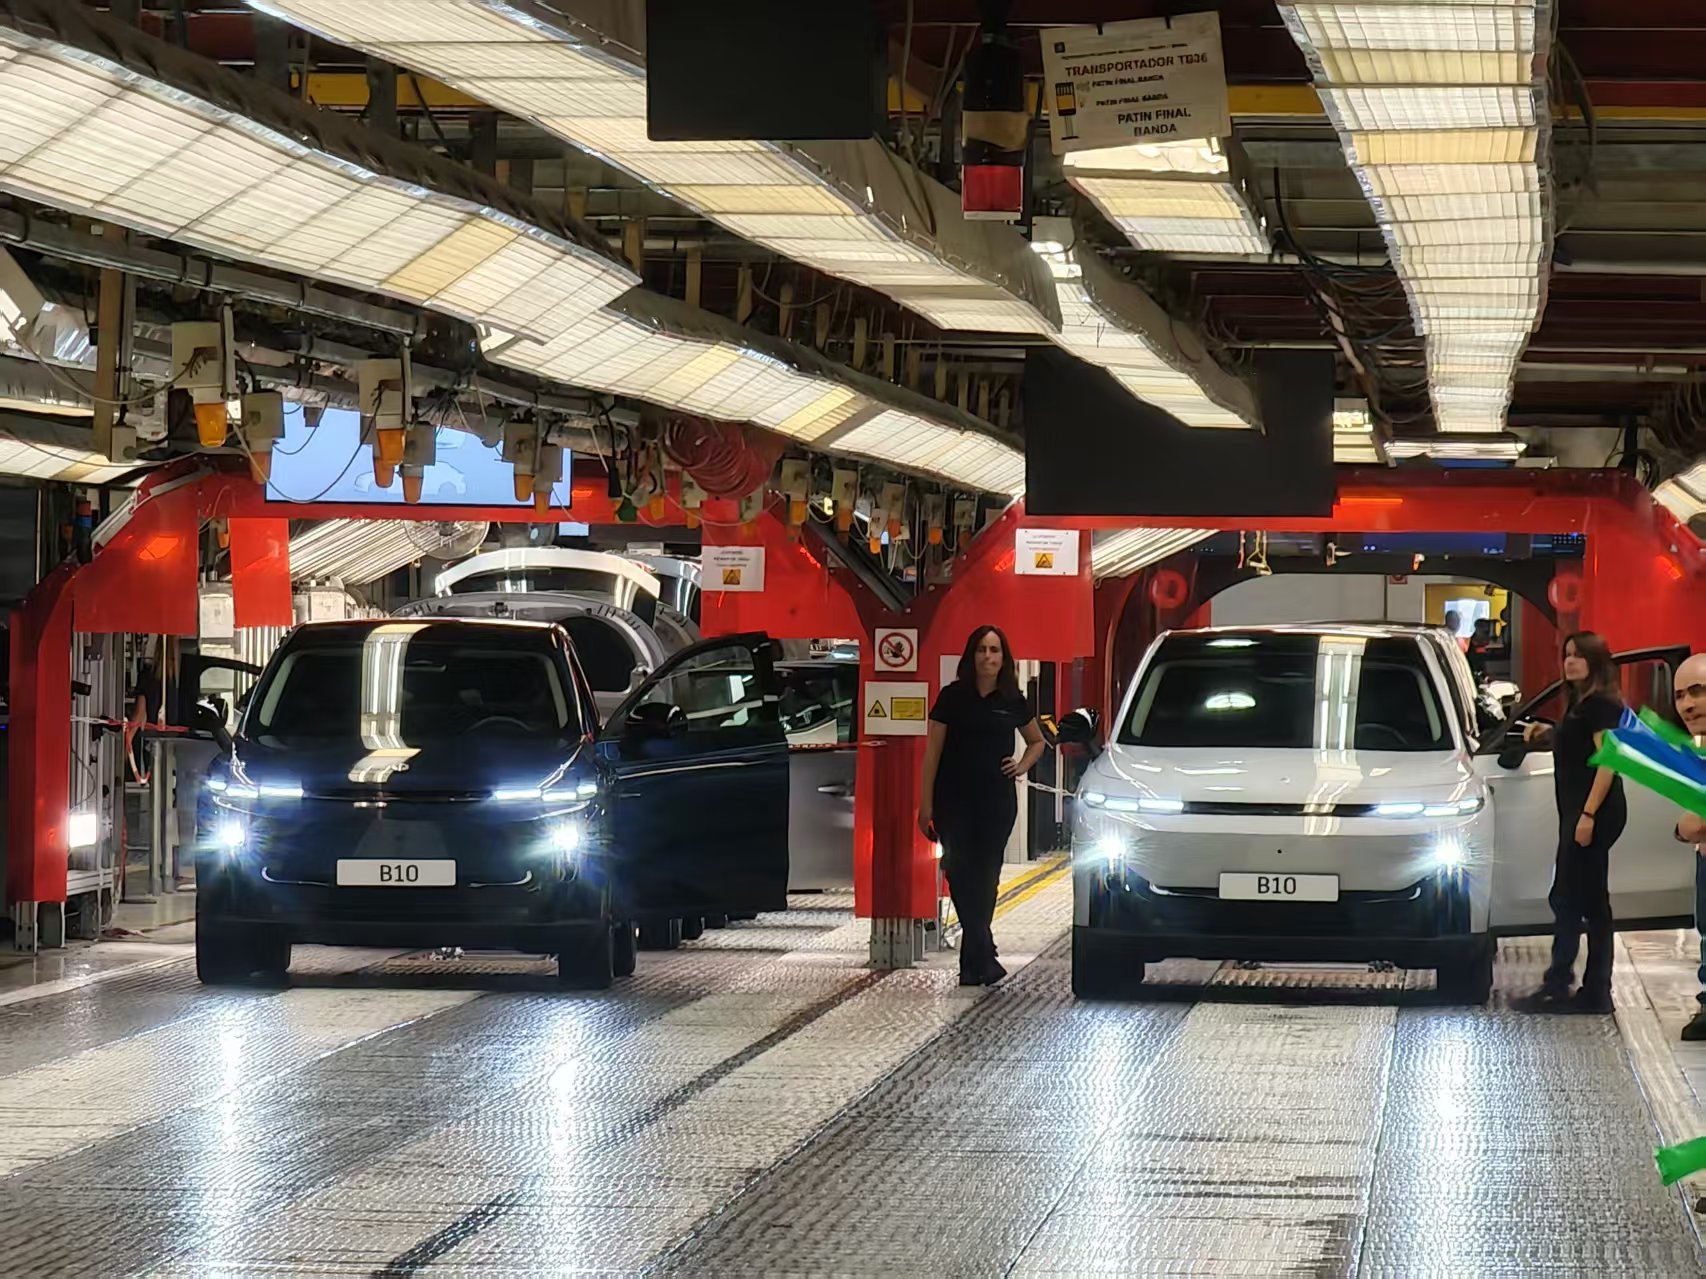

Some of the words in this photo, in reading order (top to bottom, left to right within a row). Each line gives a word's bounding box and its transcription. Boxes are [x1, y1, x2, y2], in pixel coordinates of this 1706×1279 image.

[1065, 56, 1174, 77] TRANSPORTADOR
[1117, 111, 1152, 125] PATIN
[1155, 107, 1191, 120] FINAL
[1134, 123, 1177, 137] BANDA
[379, 864, 419, 882] B10
[1257, 876, 1297, 894] B10
